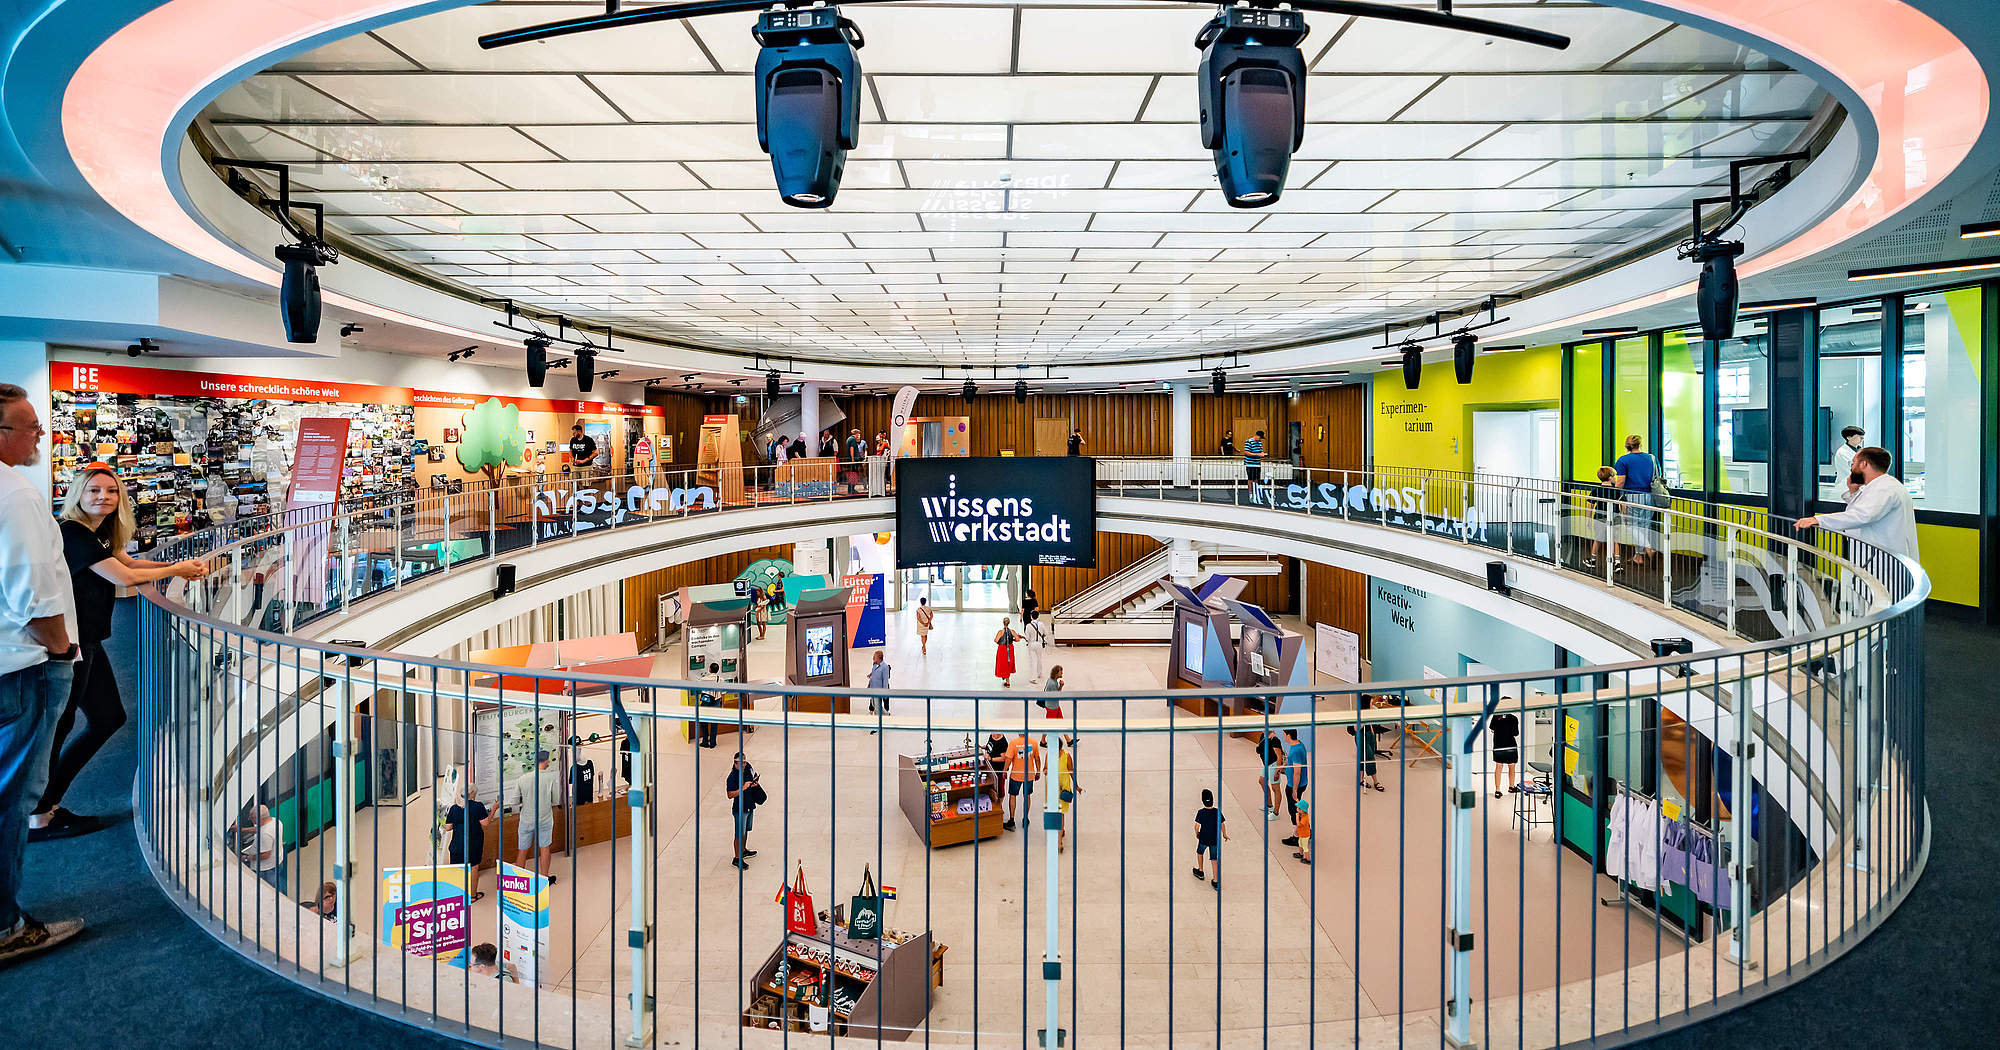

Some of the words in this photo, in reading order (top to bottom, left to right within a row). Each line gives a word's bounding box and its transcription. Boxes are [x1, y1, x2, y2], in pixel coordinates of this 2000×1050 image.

[200, 380, 237, 392] Unsere
[238, 382, 290, 395] schrecklich
[291, 386, 321, 397] schöne
[321, 388, 340, 398] Welt
[413, 394, 442, 403] eschichten
[1380, 400, 1428, 419] Experimen-
[1404, 417, 1434, 432] tarium
[920, 474, 1033, 518] Wissens
[928, 513, 1072, 543] Werkstadt
[850, 586, 866, 595] ein
[1377, 585, 1412, 610] Kreativ-
[1391, 608, 1415, 633] Werk
[477, 708, 533, 720] TEUTBURGER
[399, 902, 461, 922] Gewnn-
[412, 909, 466, 940] Spiel
